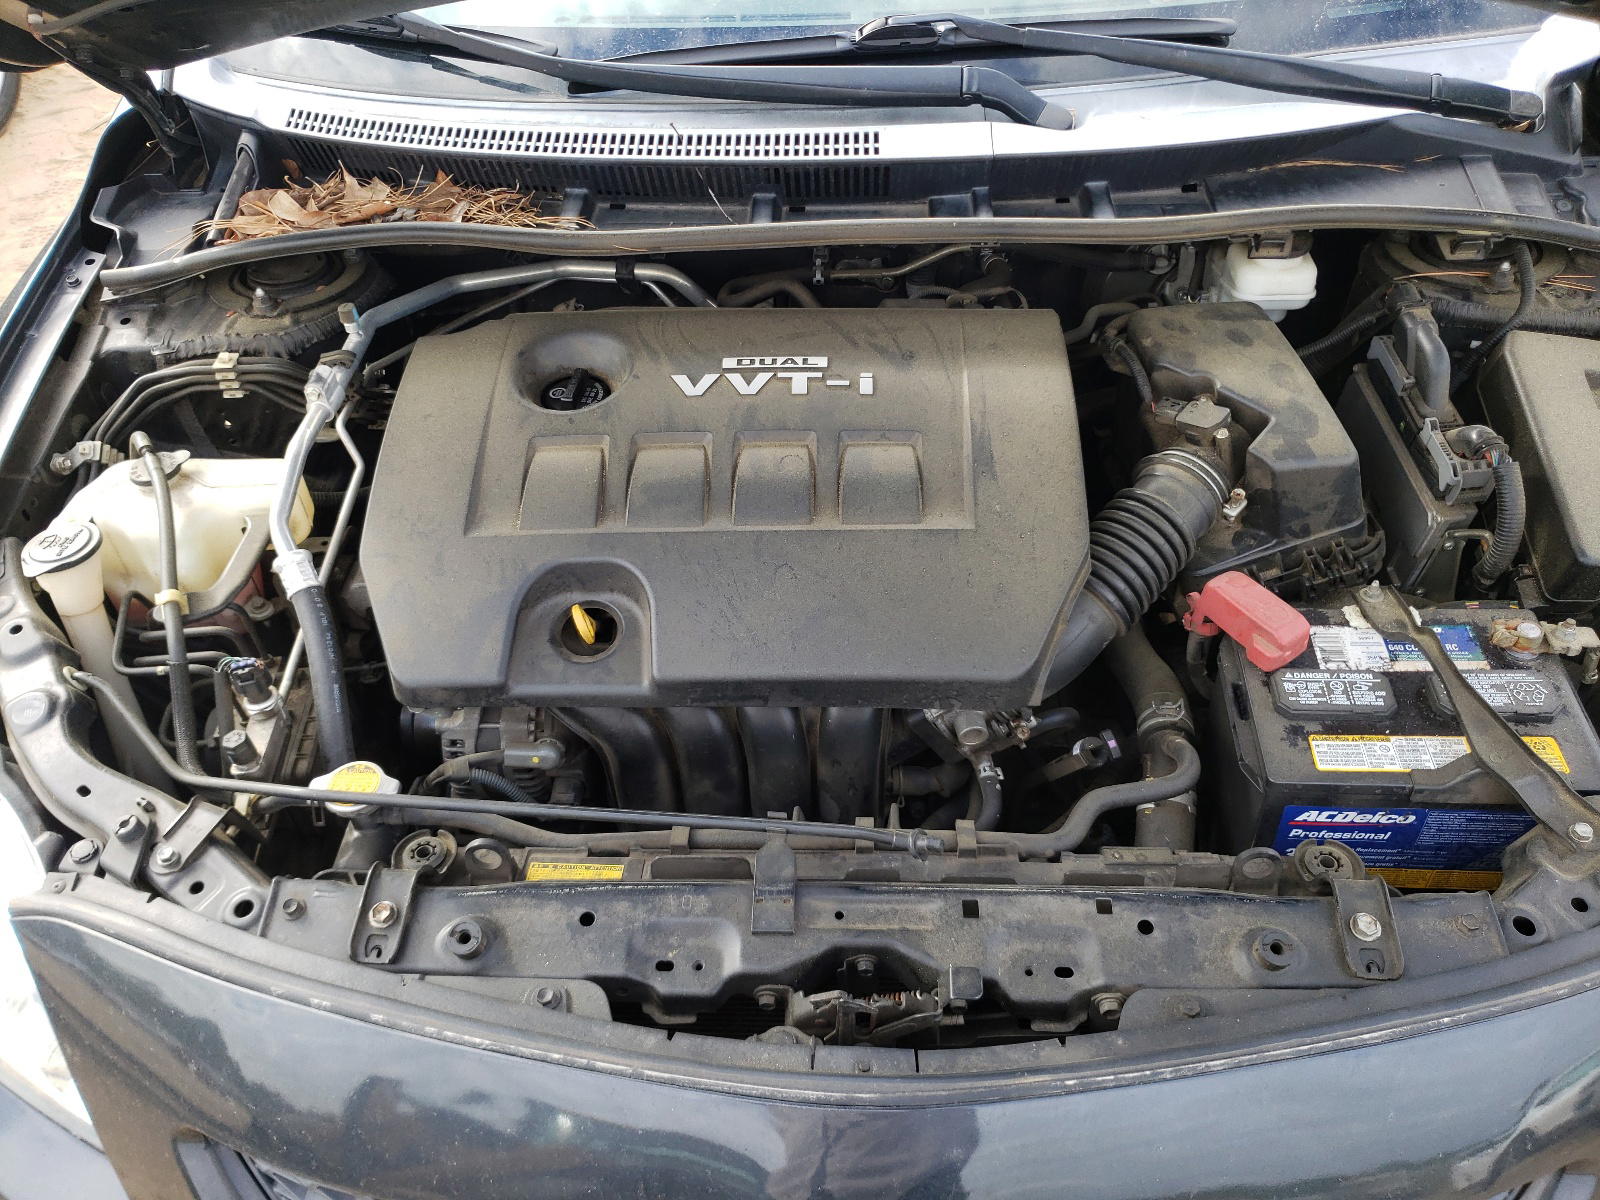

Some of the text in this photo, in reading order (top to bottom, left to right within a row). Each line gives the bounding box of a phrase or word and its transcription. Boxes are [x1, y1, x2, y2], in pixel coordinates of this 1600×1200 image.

[736, 358, 818, 366] DUAL
[670, 372, 874, 397] VVT-i
[1293, 811, 1416, 824] ACDelco
[1288, 829, 1392, 840] Professional
